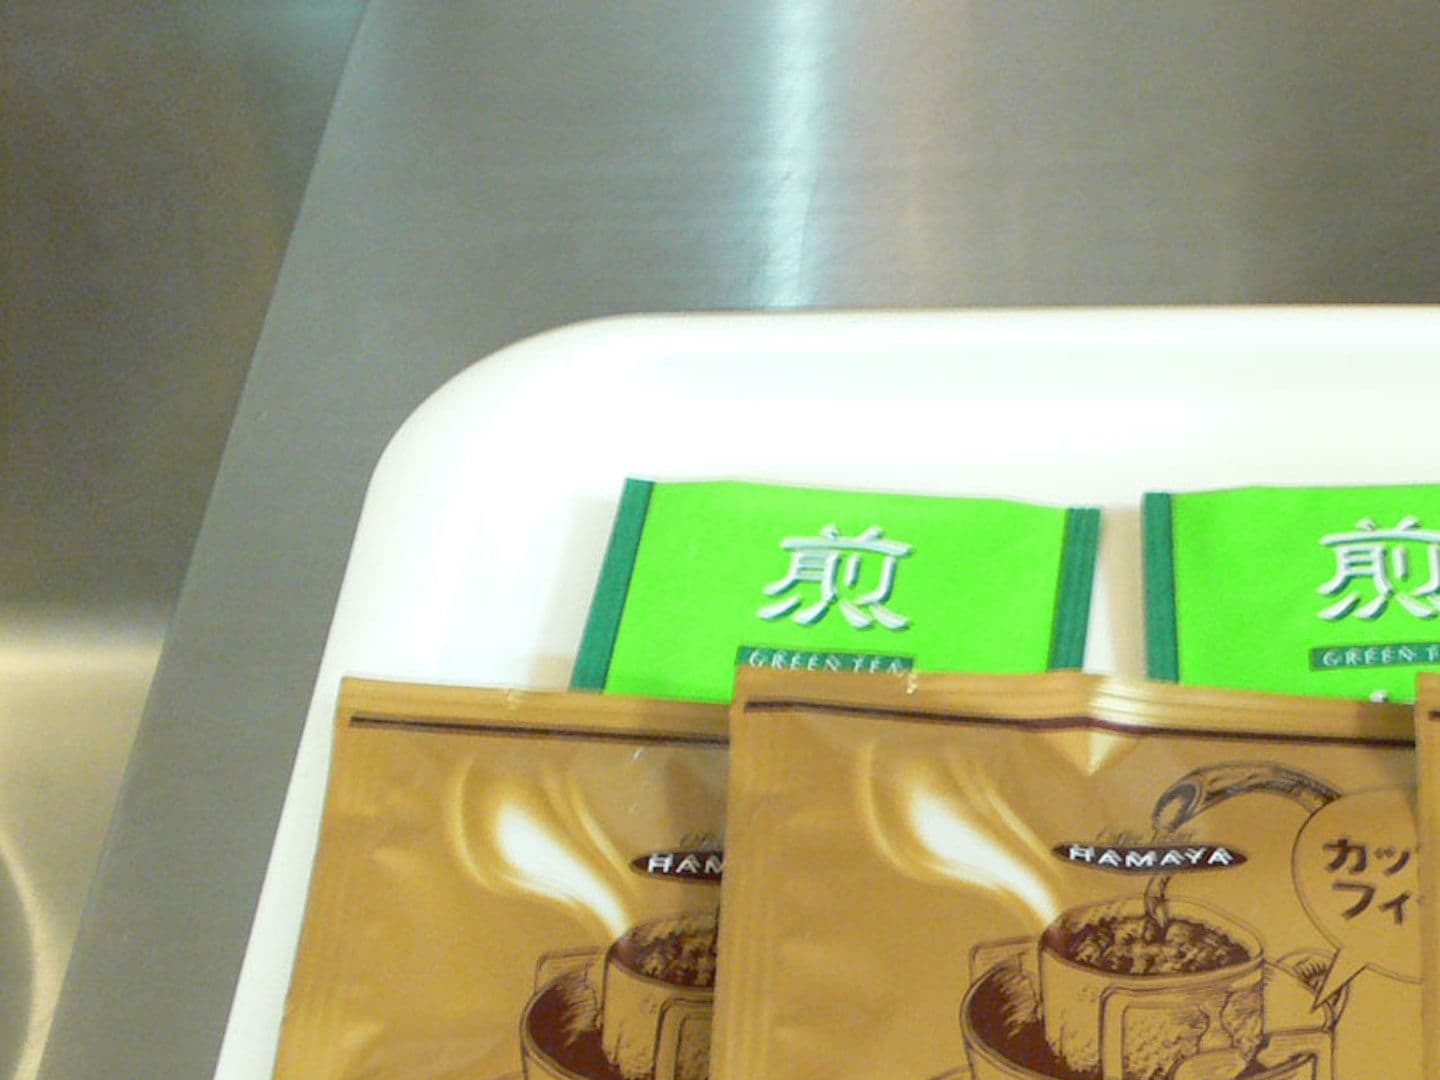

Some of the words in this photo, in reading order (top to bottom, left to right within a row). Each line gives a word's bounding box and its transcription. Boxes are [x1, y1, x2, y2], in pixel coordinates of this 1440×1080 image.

[756, 523, 912, 630] 煎
[749, 648, 842, 672] GREEN
[853, 655, 902, 675] TEA
[1321, 647, 1418, 668] GREEN
[1068, 843, 1234, 868] HAMAYA
